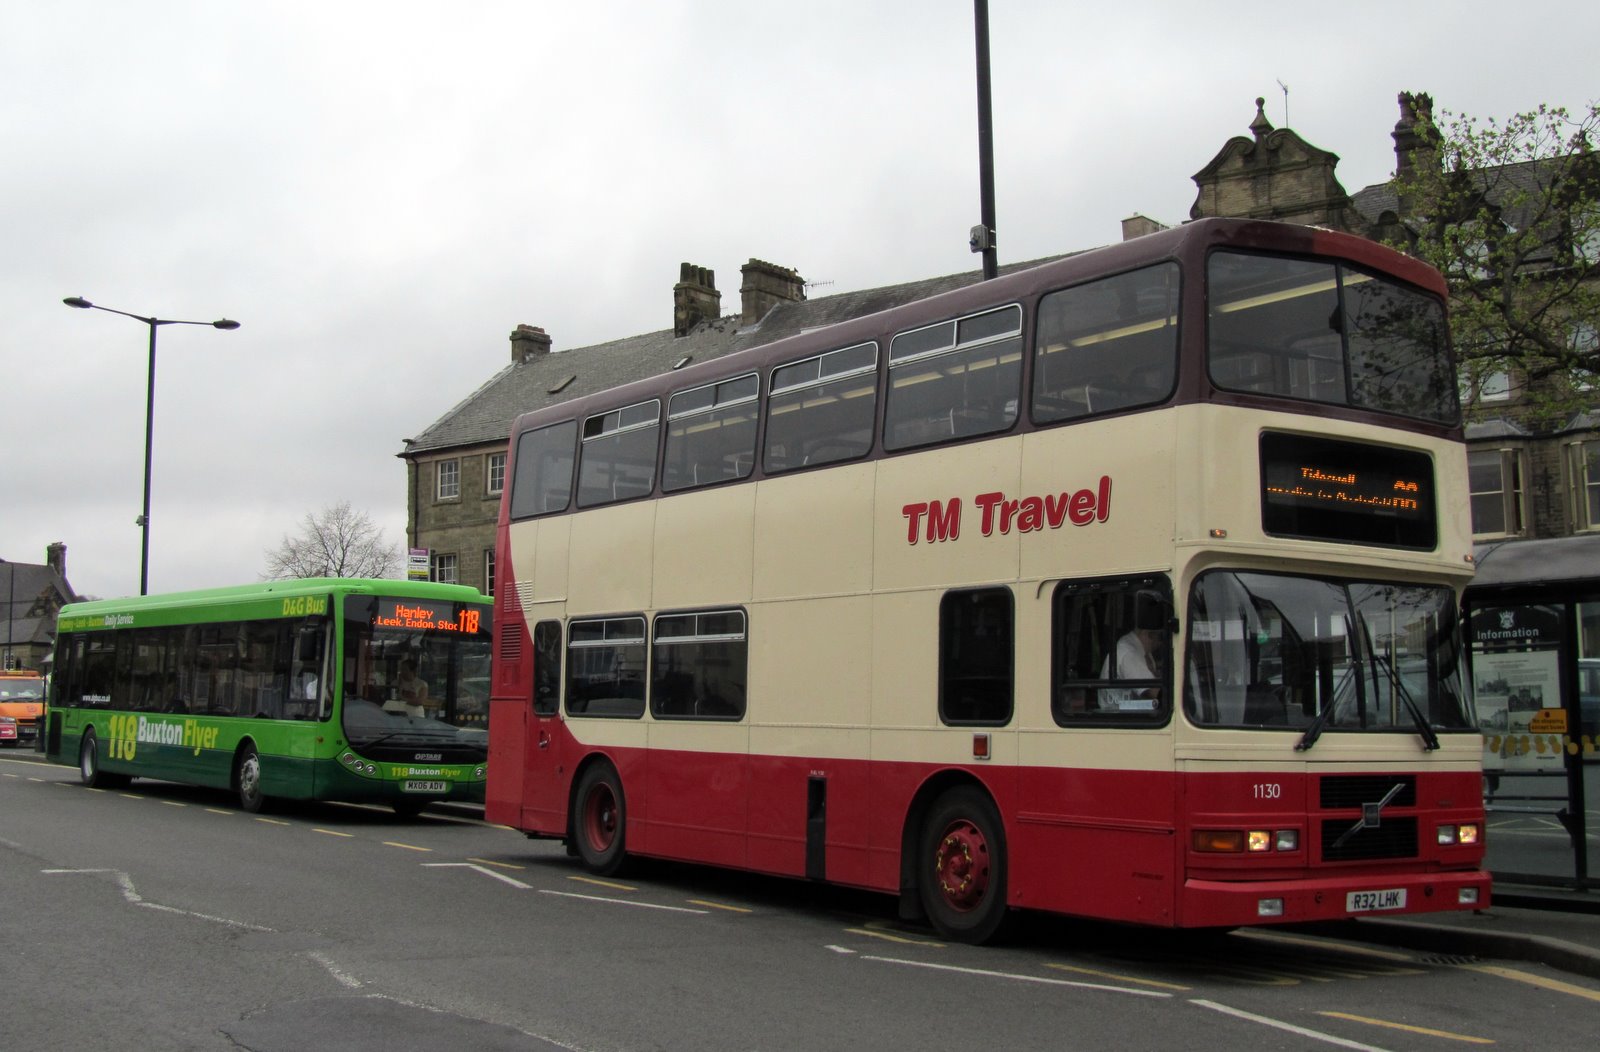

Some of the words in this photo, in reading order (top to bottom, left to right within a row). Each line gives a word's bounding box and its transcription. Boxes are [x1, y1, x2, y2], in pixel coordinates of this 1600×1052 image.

[902, 497, 962, 545] TM
[975, 475, 1112, 537] Travel
[283, 597, 304, 616] D&G
[306, 596, 325, 614] Bus
[395, 604, 434, 619] Hanley
[104, 614, 117, 629] Daily
[117, 613, 134, 625] Service
[459, 609, 480, 633] 118
[1477, 627, 1539, 640] Information
[109, 715, 137, 760] 118
[408, 781, 428, 790] MX06
[430, 782, 443, 790] ADV
[1253, 783, 1281, 799] 1130
[1354, 893, 1376, 909] R32
[1378, 891, 1400, 907] LHK
